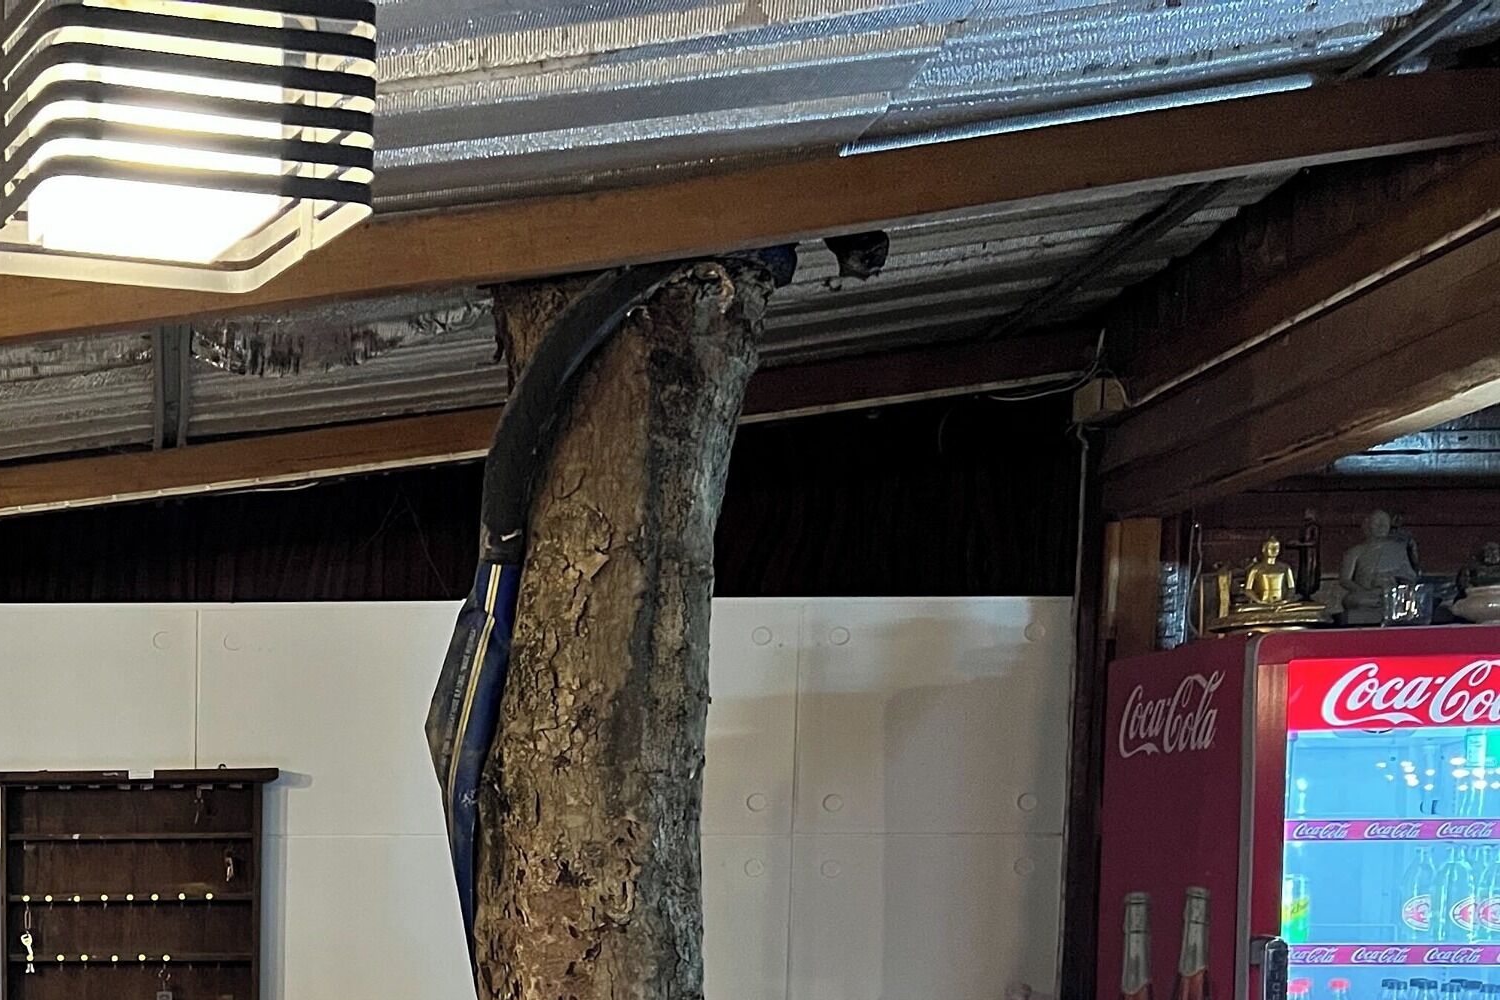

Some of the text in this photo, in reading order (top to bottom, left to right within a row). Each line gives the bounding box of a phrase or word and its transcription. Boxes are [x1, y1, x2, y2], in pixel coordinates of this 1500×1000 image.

[1321, 660, 1500, 726] Coca-Co
[1119, 670, 1225, 758] Coca-Cola
[1293, 822, 1495, 839] Coca-Cola Coca-Cola Coca-Cola
[1351, 947, 1411, 963] Coca-Cola
[1424, 947, 1484, 963] Coca-Cola
